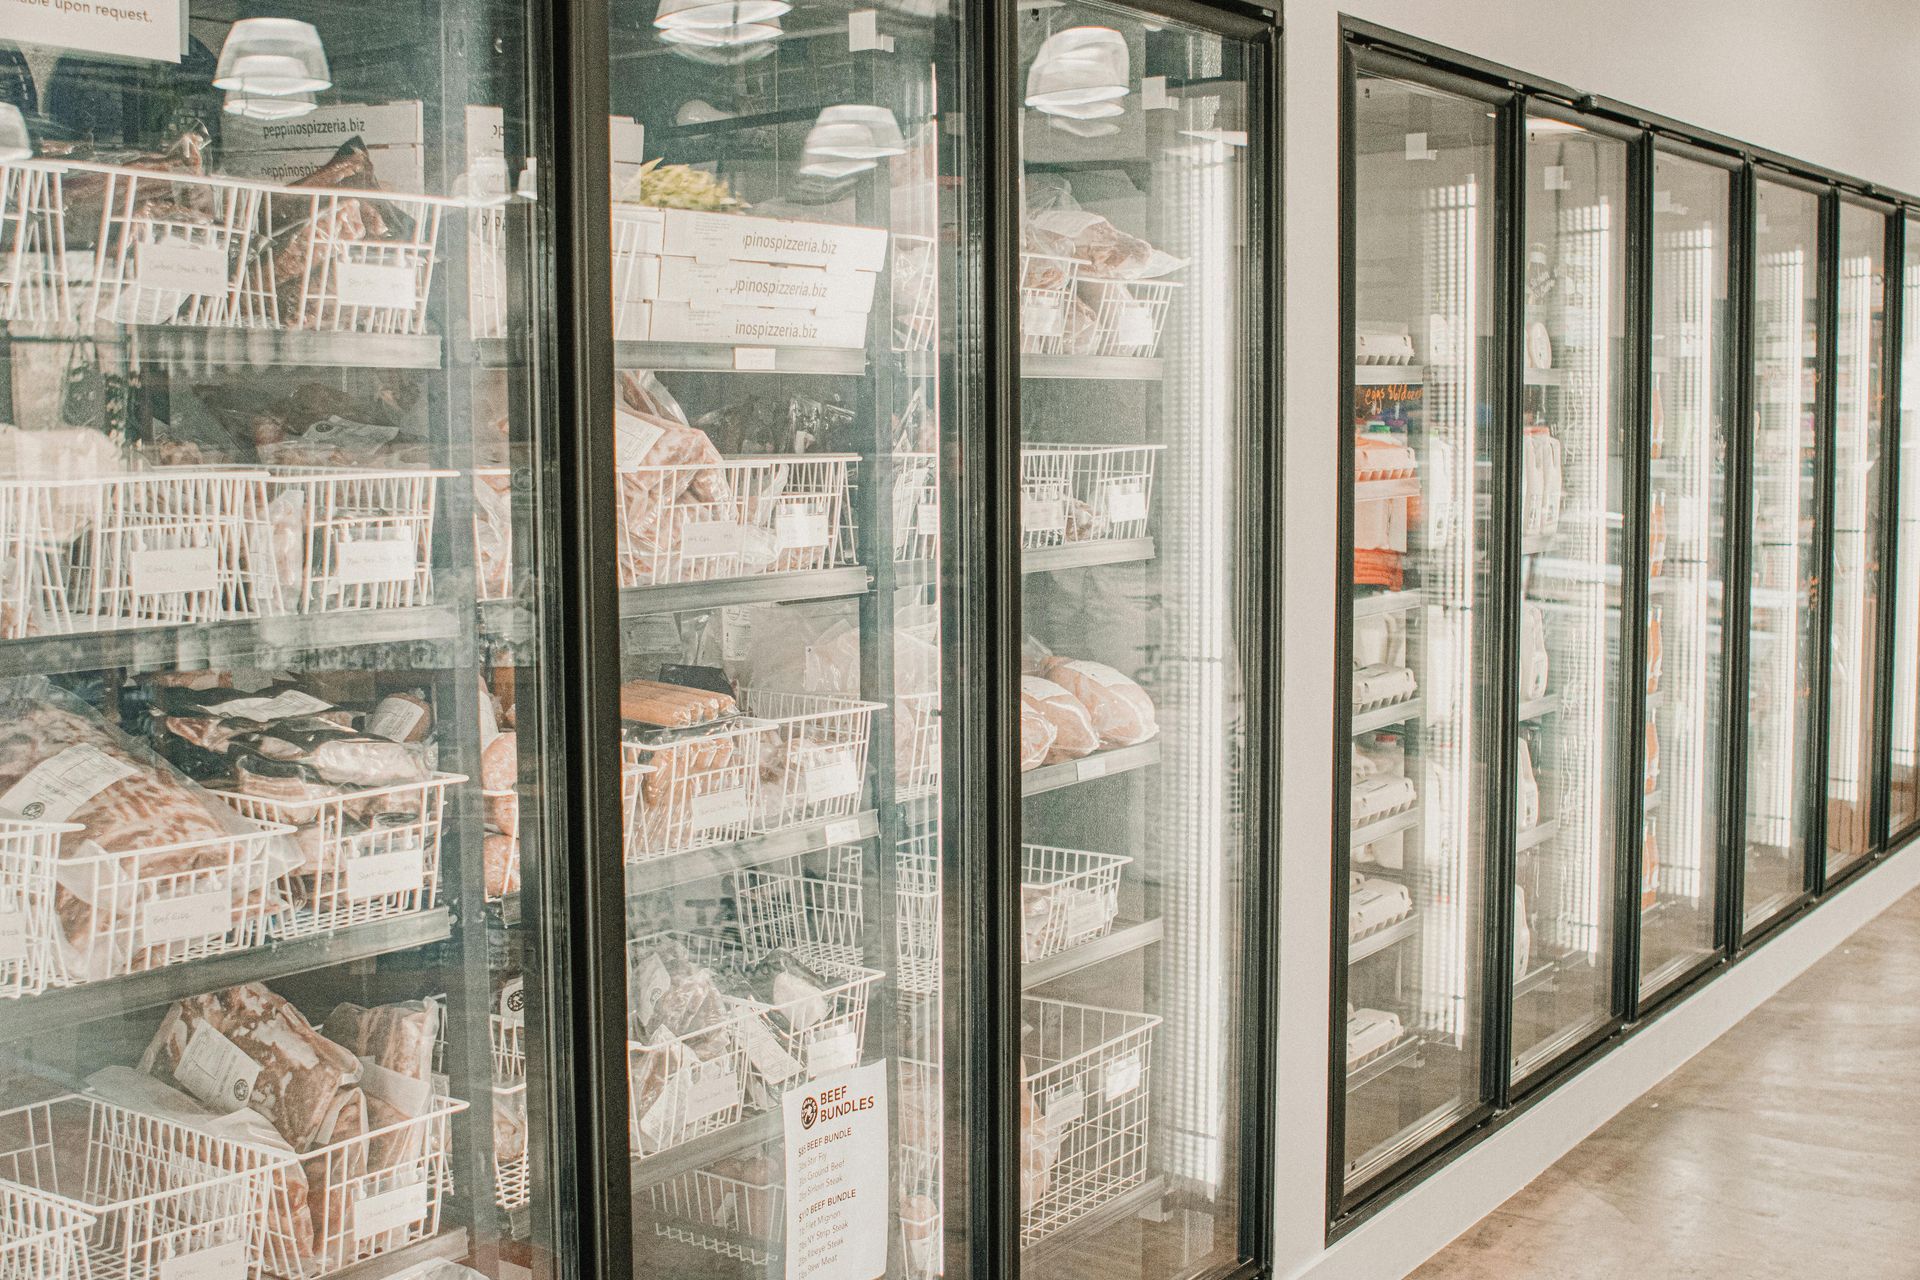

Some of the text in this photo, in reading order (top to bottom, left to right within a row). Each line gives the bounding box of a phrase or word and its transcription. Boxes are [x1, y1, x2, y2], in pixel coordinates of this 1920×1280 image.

[55, 0, 91, 13] upon
[95, 5, 153, 23] request.
[263, 118, 366, 139] peppinospizzeria.biz
[820, 1085, 847, 1106] BEEF
[820, 1095, 875, 1123] BUNDLES
[807, 1136, 823, 1151] BEEF
[824, 1127, 852, 1145] BUNDLE
[807, 1164, 829, 1181] Ground
[810, 1199, 826, 1214] BEEF
[827, 1188, 856, 1207] BUNDLE
